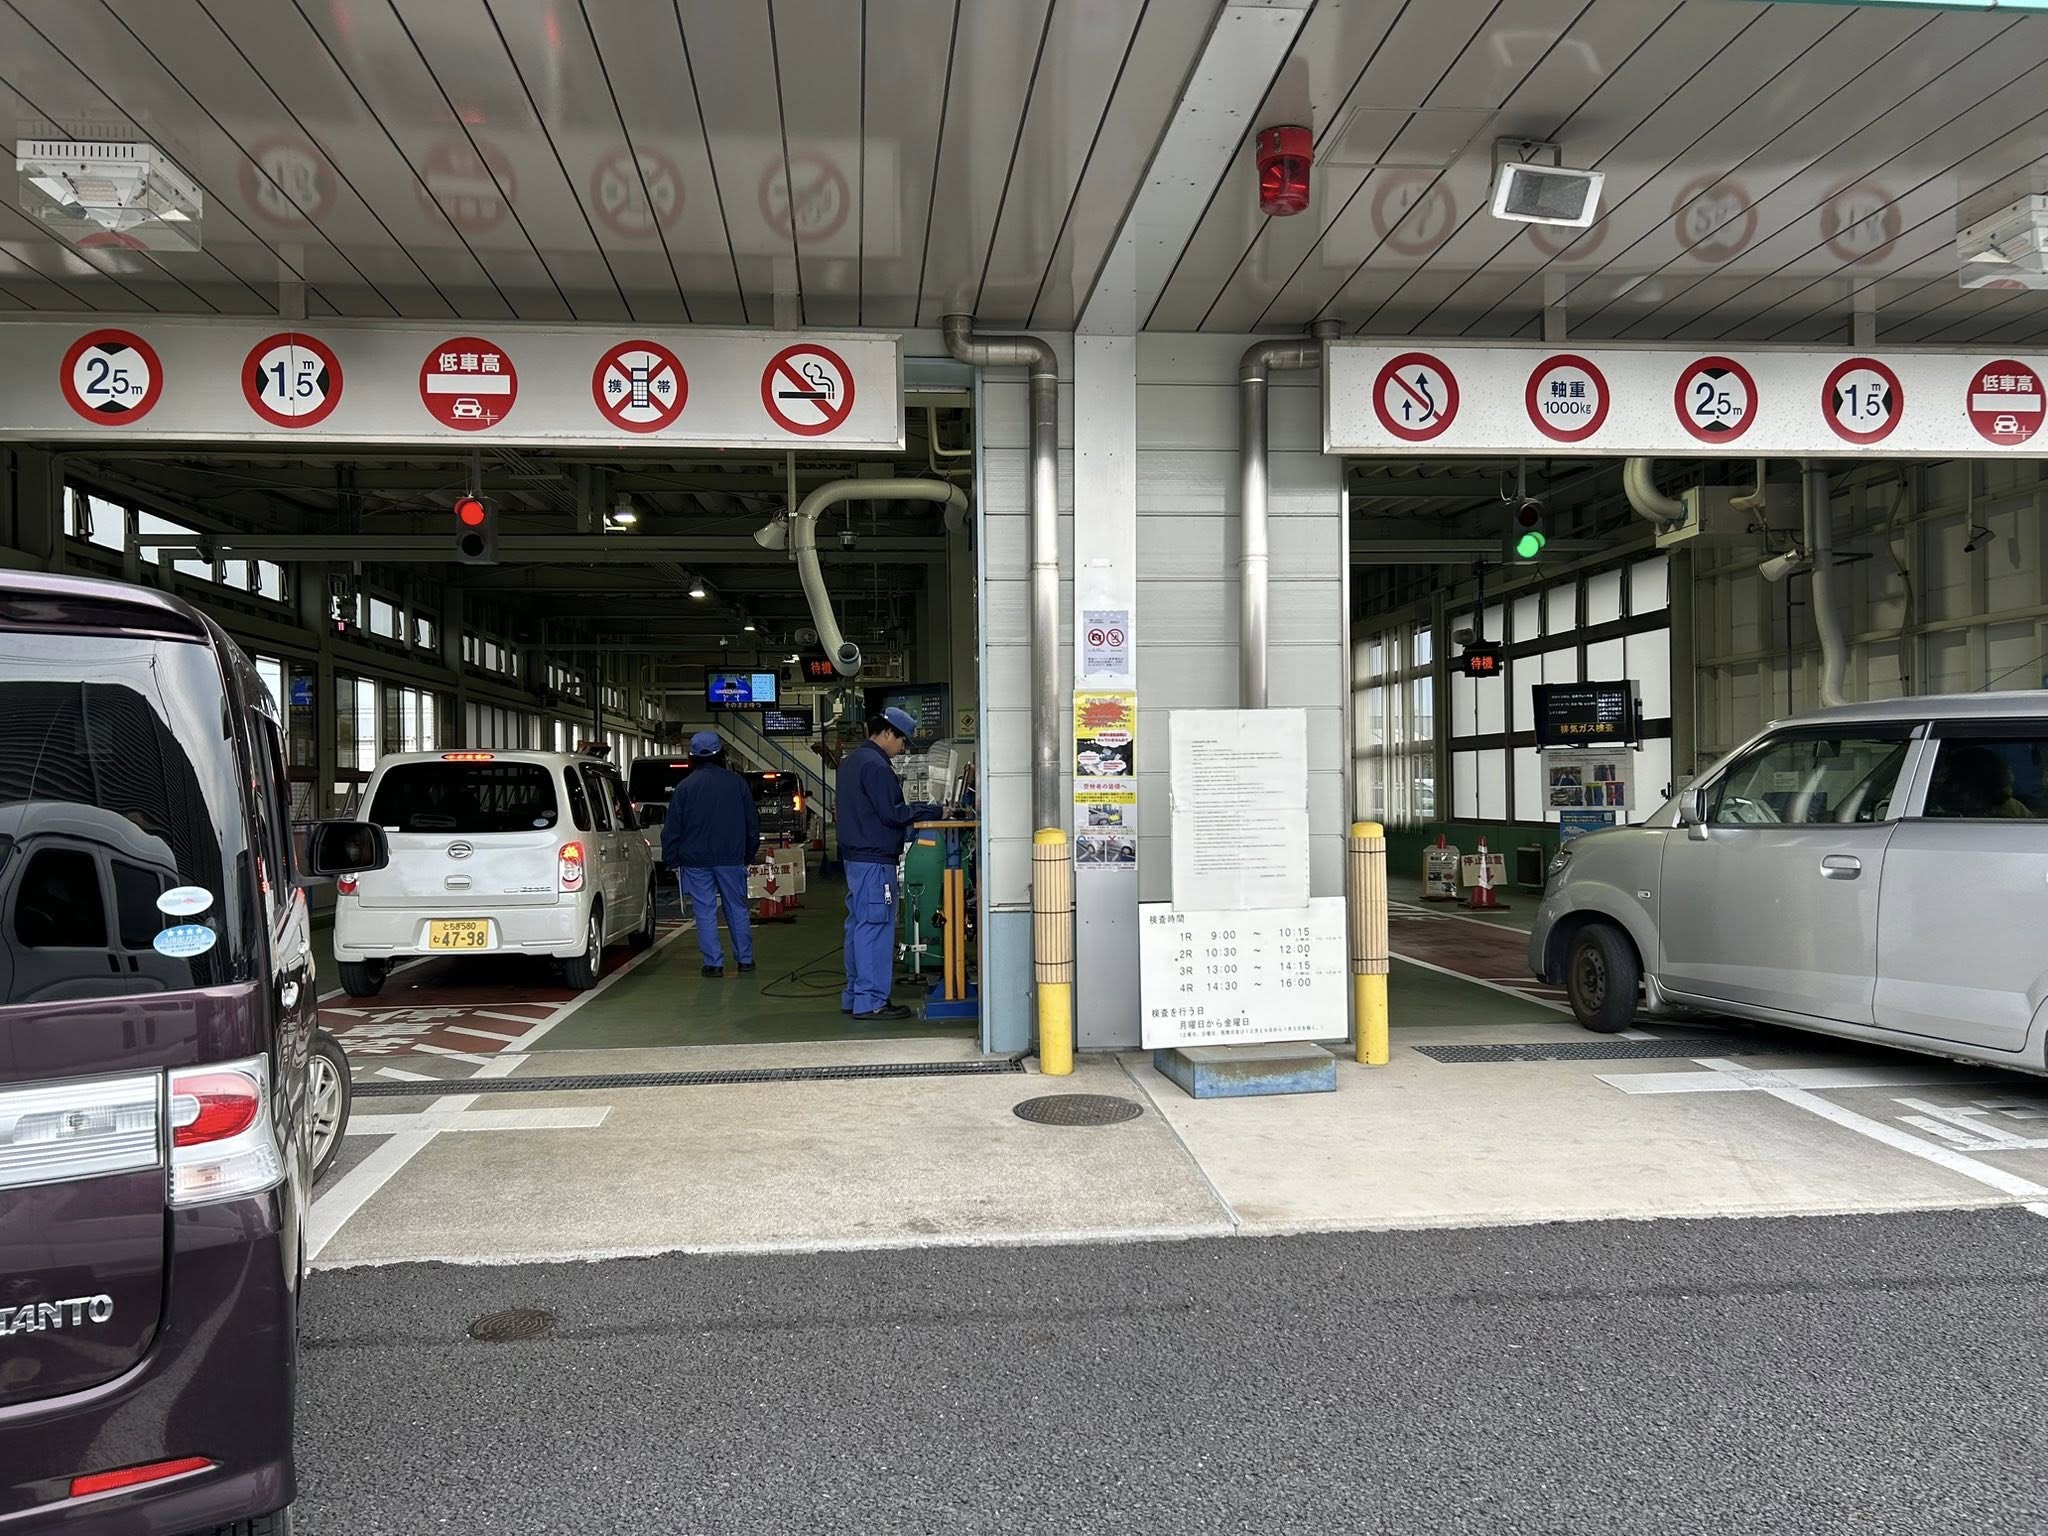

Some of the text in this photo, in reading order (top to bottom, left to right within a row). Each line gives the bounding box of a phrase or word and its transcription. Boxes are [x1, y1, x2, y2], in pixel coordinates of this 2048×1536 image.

[438, 353, 500, 373] 低車高
[1550, 381, 1586, 398] 軸重
[1982, 375, 2033, 393] 低車高
[1543, 401, 1591, 415] 1000kg
[1470, 656, 1494, 670] 待機
[1560, 723, 1615, 734] 排気ガス検査
[1149, 914, 1185, 925] 検査時間
[442, 931, 485, 947] 47-98
[1180, 932, 1192, 942] 1R
[1211, 930, 1236, 940] 9:00
[1279, 927, 1310, 937] 10:15
[1179, 950, 1193, 959] 2R
[1206, 947, 1237, 957] 10:30
[1280, 944, 1310, 954] 12:00
[1179, 966, 1193, 976] 3R
[1206, 964, 1237, 974] 13:00
[1280, 961, 1311, 971] 14:15
[1179, 983, 1194, 993] 4R
[1207, 981, 1238, 991] 14:30
[1280, 977, 1311, 987] 16:00
[1151, 1006, 1204, 1018] 検査を行う日
[1179, 1018, 1250, 1030] 月曜日から金曜日
